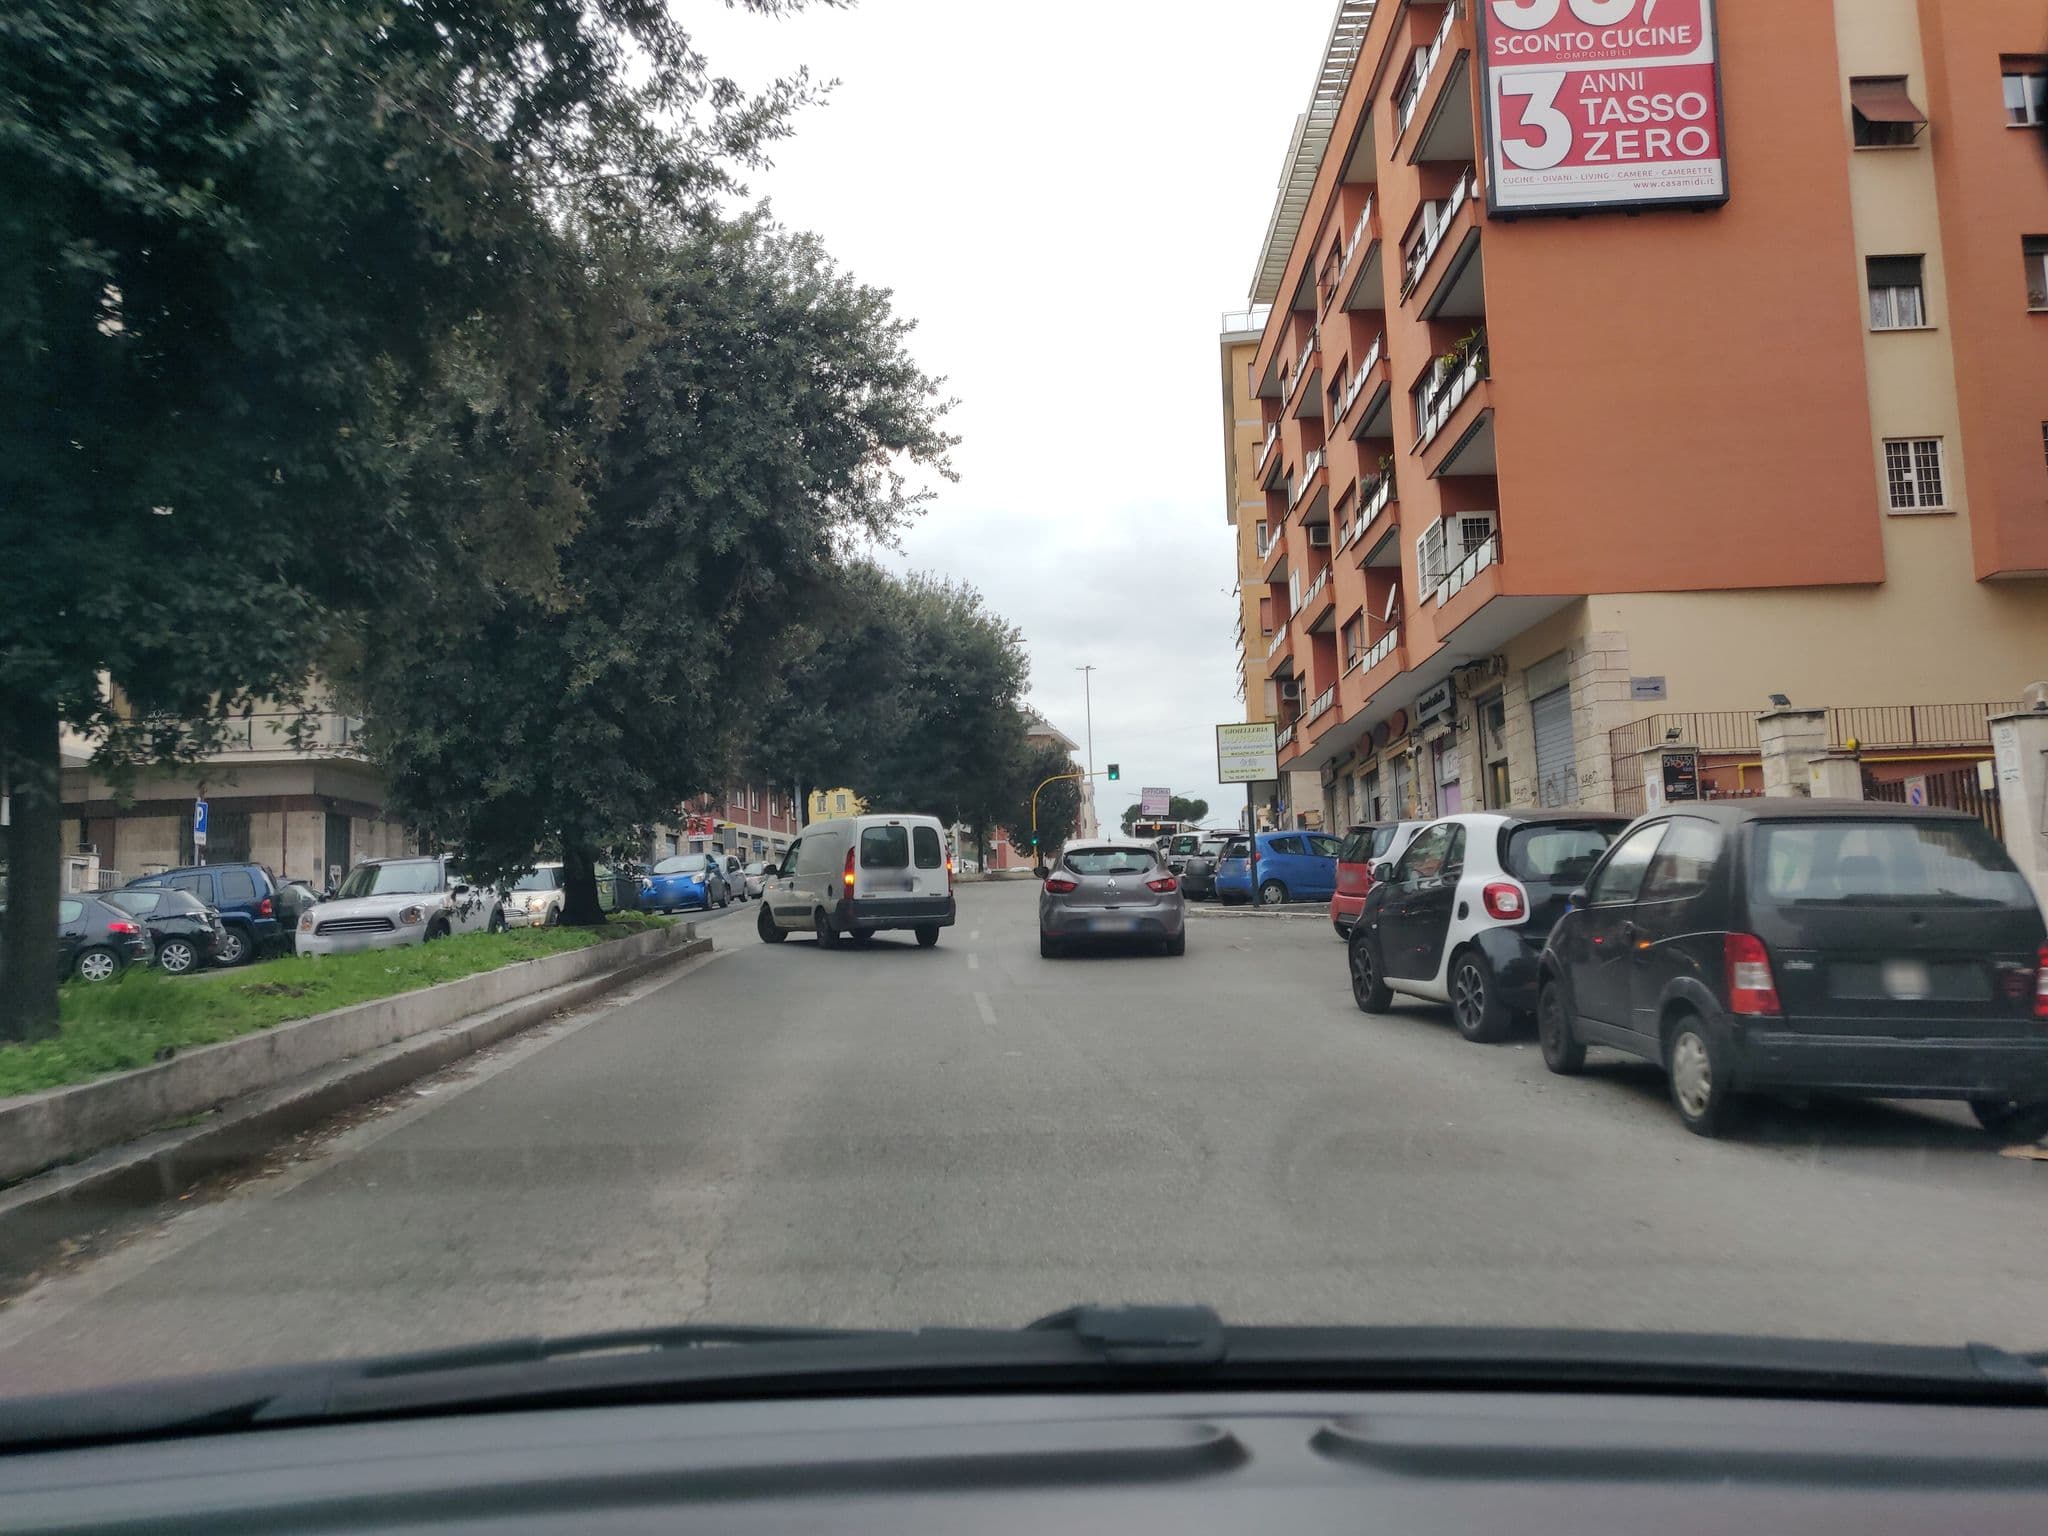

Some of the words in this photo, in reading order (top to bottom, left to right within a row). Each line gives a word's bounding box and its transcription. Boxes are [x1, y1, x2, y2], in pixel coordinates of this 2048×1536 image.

[1494, 31, 1594, 55] SCONTO
[1601, 25, 1692, 48] CUCINE
[1555, 49, 1631, 60] COMPONIBILI
[1580, 71, 1644, 94] ANNI
[1579, 92, 1708, 125] TASSO
[1501, 72, 1573, 170] 3
[1583, 126, 1710, 161] ZERO
[1503, 175, 1535, 184] CUCINE
[1580, 172, 1609, 180] LIVING
[1617, 170, 1653, 178] CAMERE
[1661, 167, 1713, 176] CAMERETTE
[1633, 178, 1714, 188] www.casamidi.it
[195, 806, 204, 828] P
